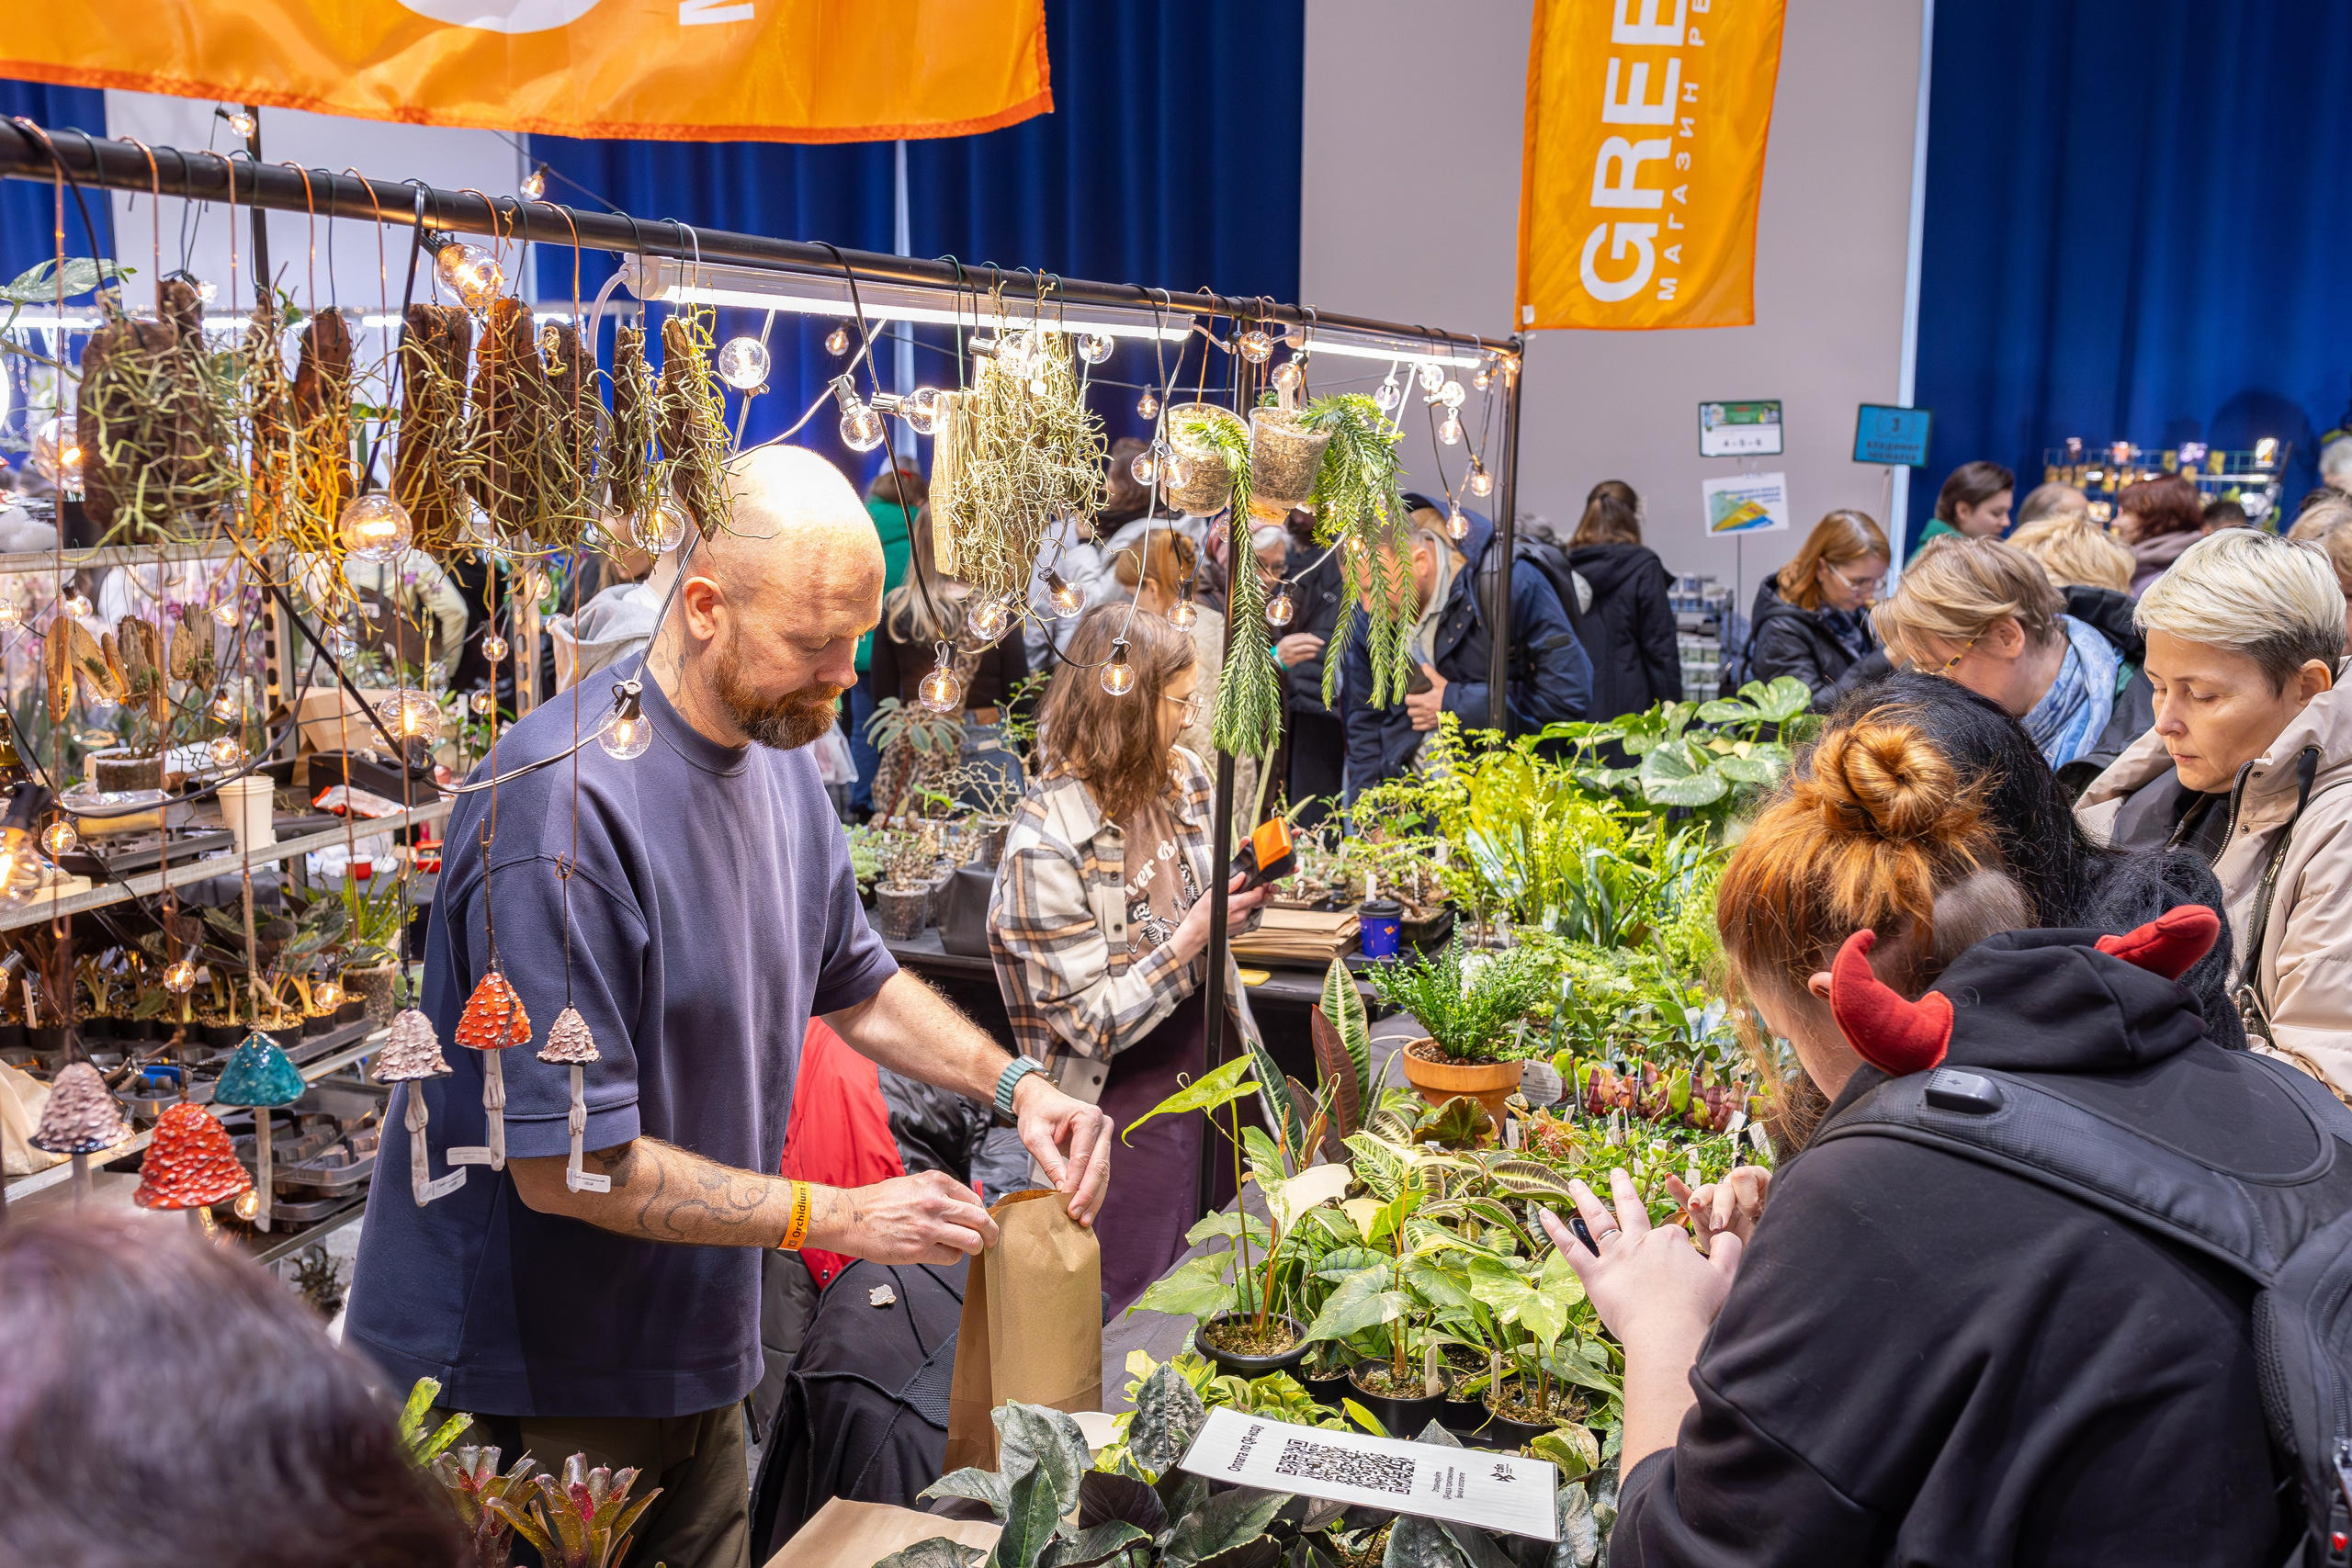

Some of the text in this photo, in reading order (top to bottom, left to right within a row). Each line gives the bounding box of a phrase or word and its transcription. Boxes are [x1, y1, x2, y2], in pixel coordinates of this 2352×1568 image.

[1657, 82, 1699, 300] МАГАЗИН
[1125, 859, 1156, 896] ver
[1227, 1424, 1264, 1472] Оплата по QR-коду
